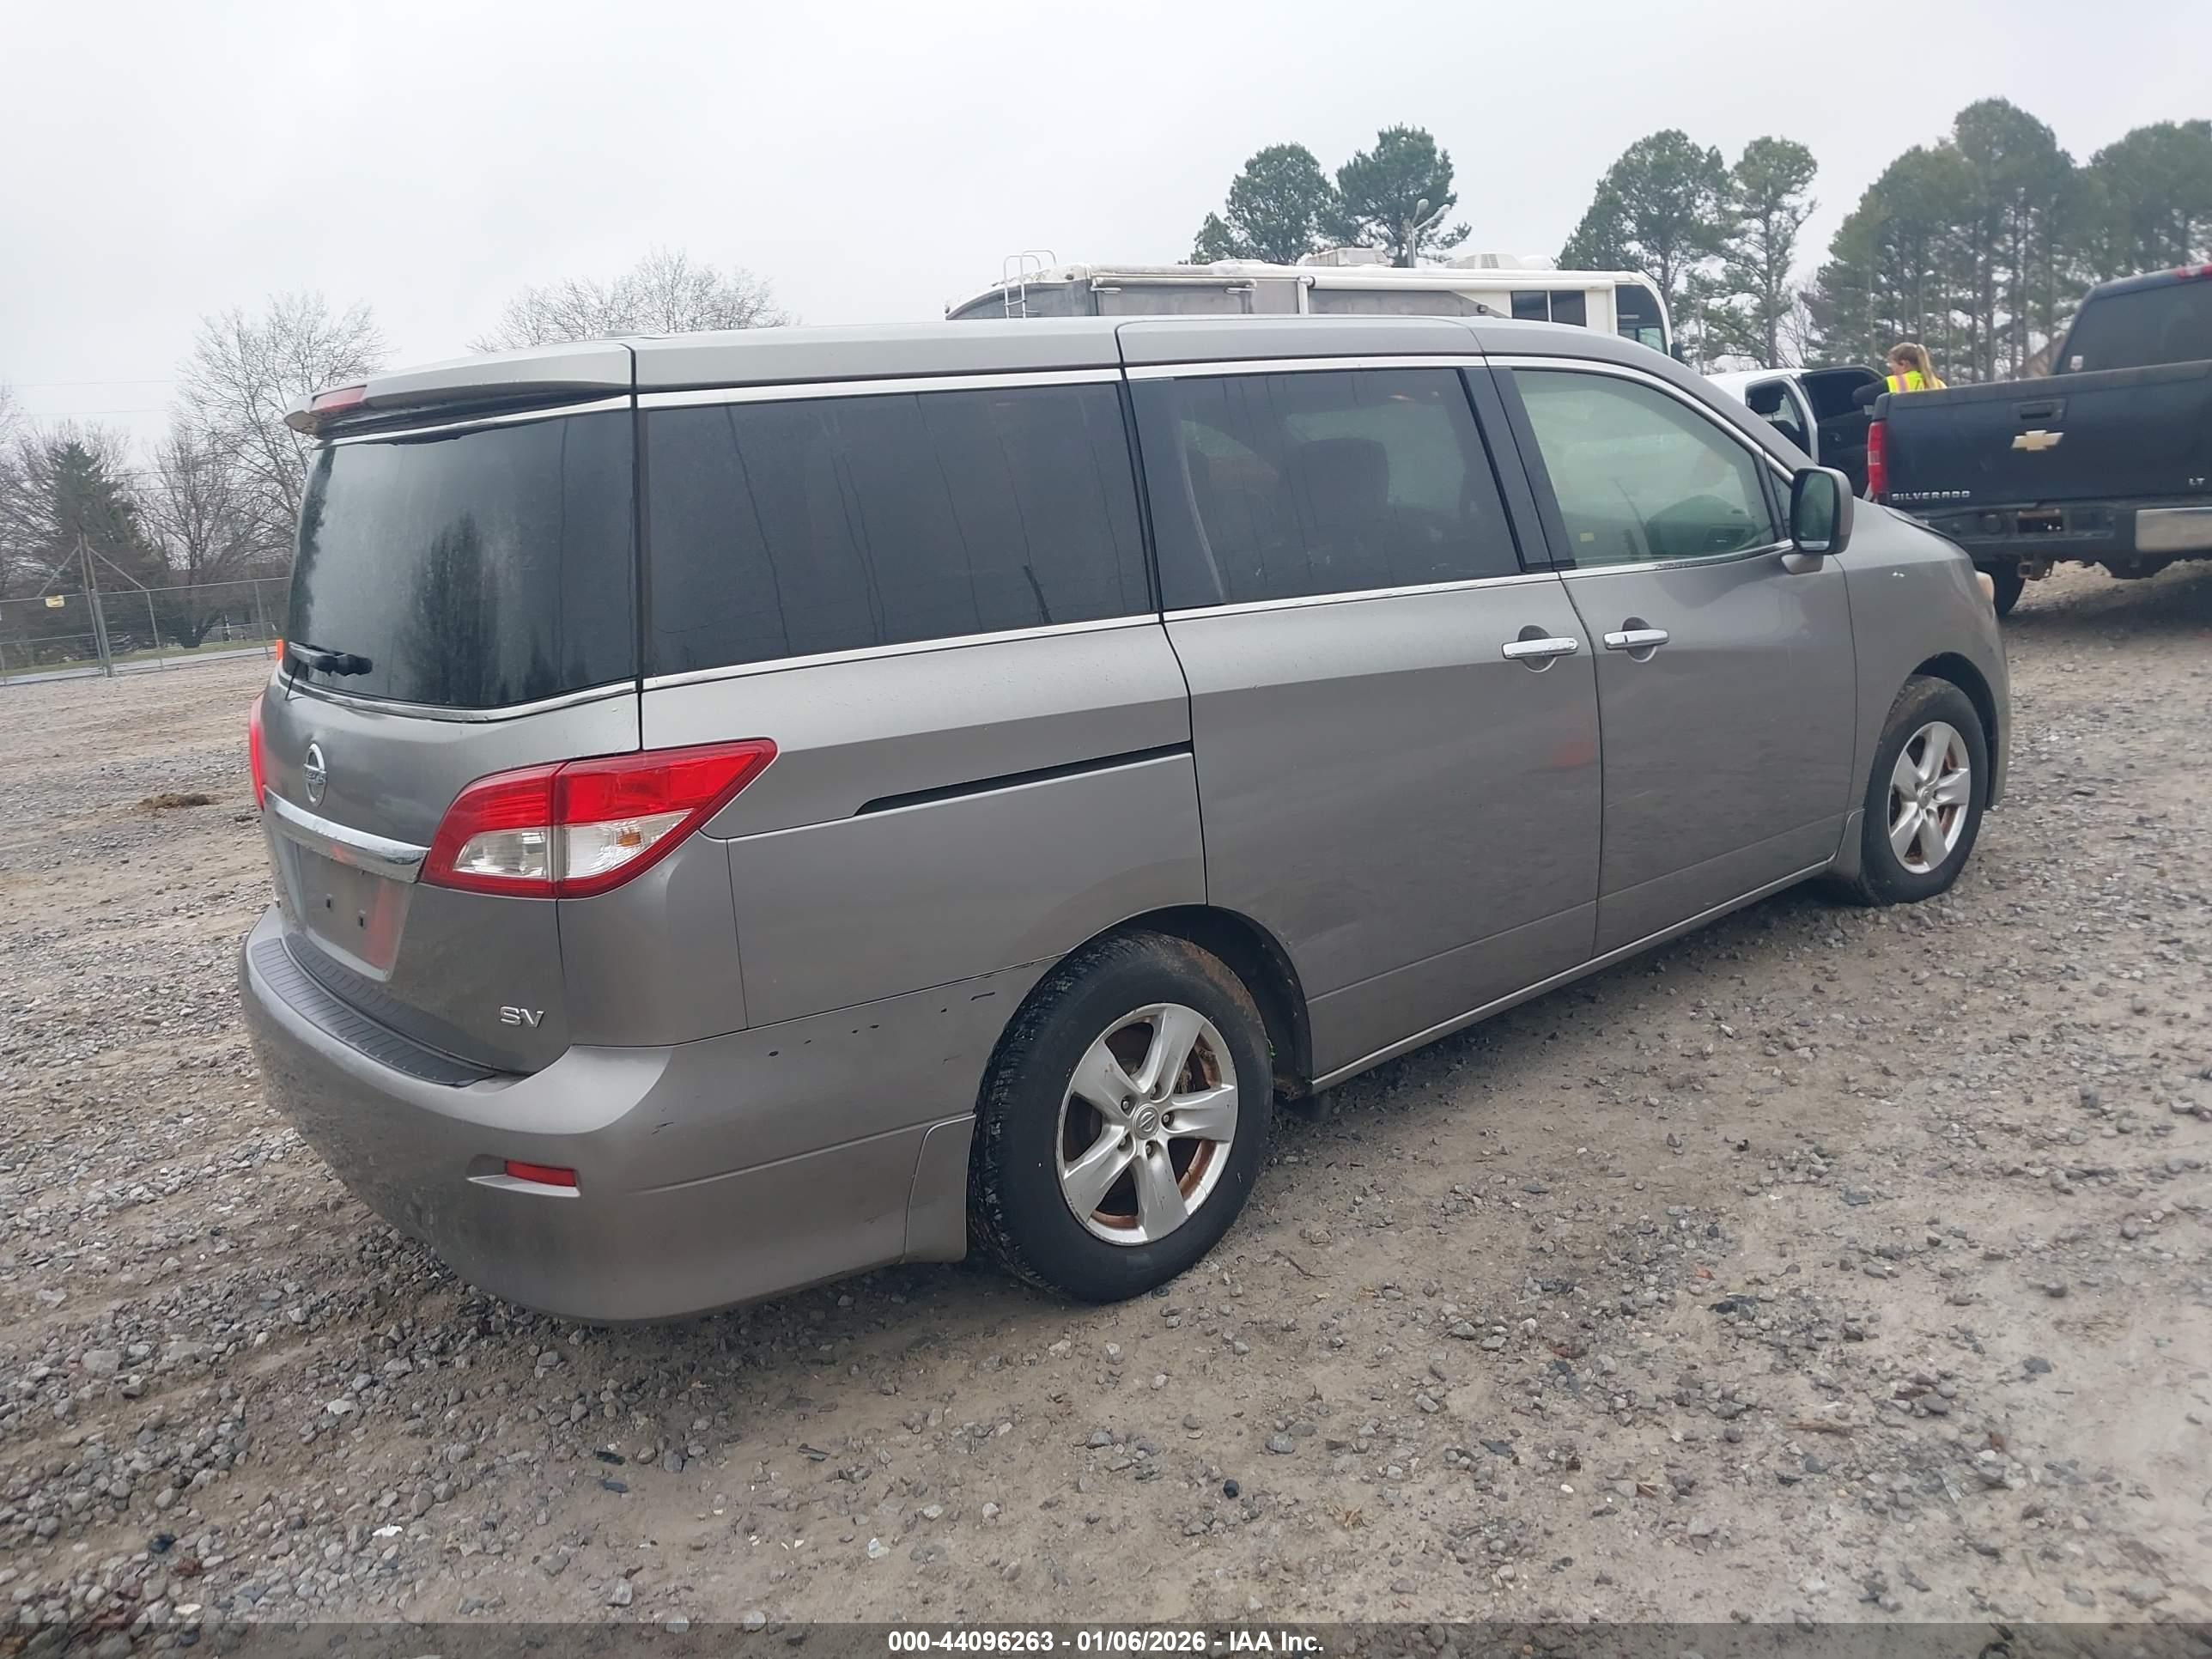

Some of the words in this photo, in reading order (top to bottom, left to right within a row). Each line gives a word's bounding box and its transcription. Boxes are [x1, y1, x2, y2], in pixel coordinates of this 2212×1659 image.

[2189, 477, 2205, 486] LT
[1891, 490, 1971, 501] SILVERADO
[500, 1006, 544, 1028] SV
